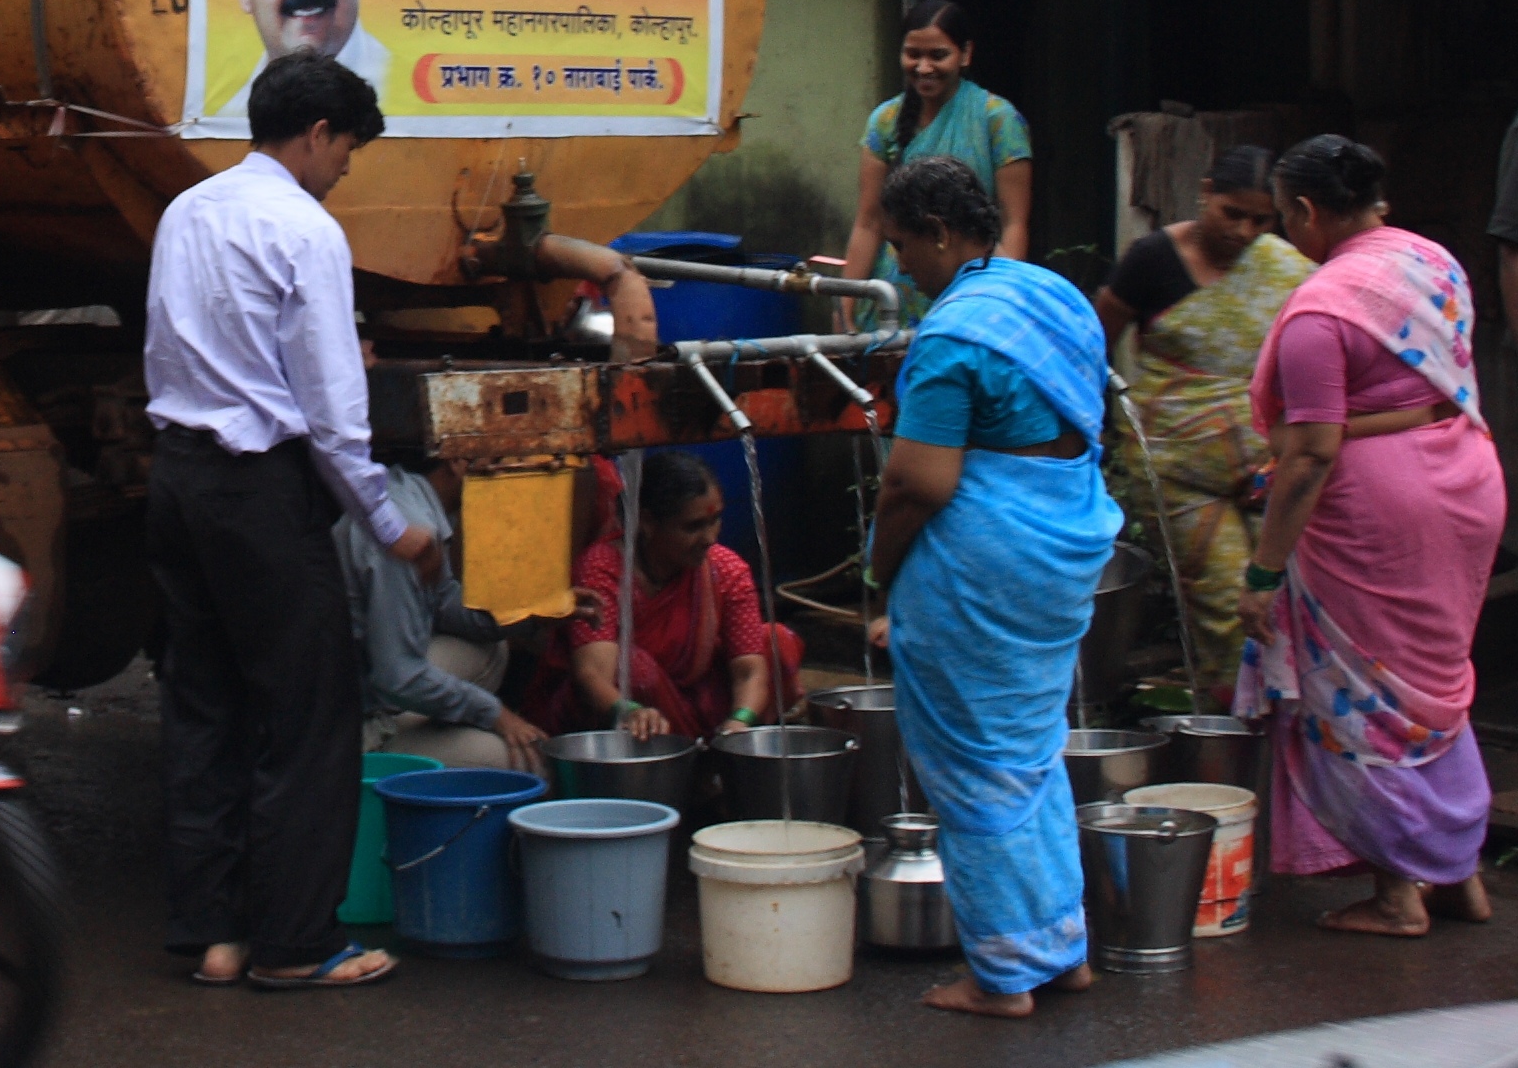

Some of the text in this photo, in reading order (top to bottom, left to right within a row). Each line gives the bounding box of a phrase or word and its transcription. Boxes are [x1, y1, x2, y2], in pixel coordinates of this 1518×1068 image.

[401, 0, 698, 45] कोल्हापूर महानगरपालिका, कोल्हापूर.
[439, 58, 664, 96] प्रभाग क्र. १० ताराबाई पार्क.
